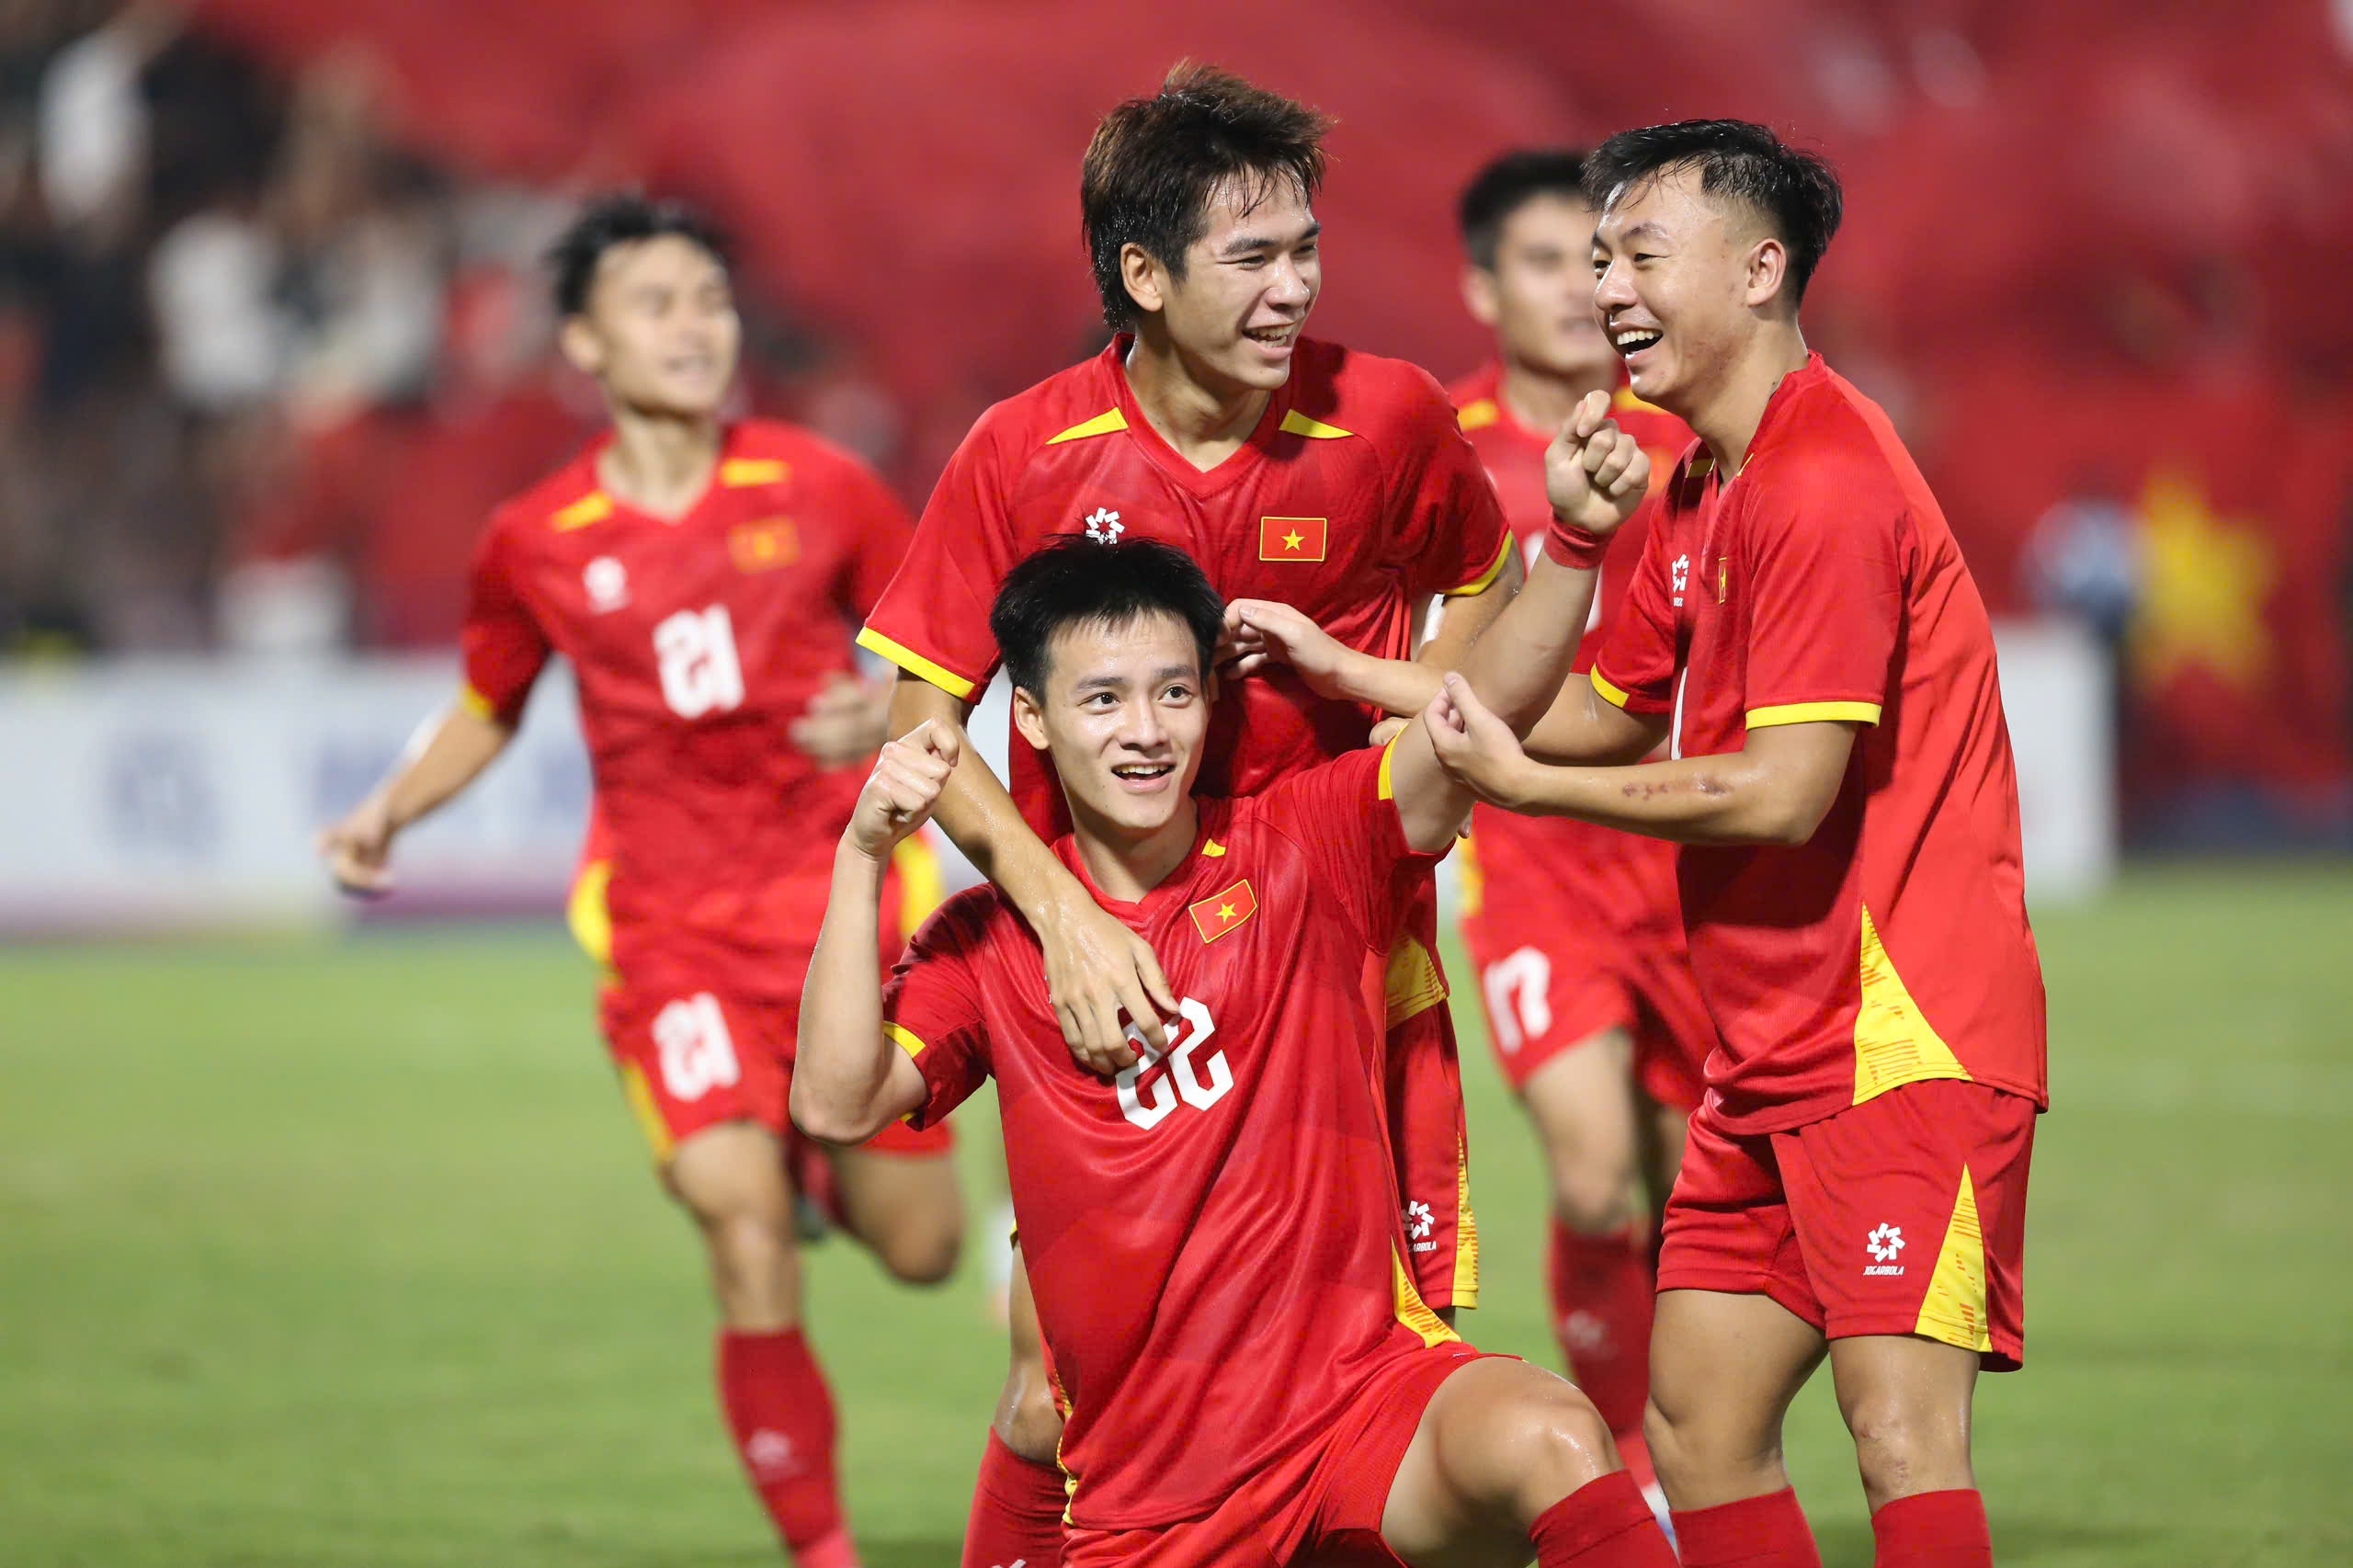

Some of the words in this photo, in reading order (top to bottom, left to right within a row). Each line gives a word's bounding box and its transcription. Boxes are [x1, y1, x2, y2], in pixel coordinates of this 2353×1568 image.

[652, 602, 745, 719] 21
[651, 992, 742, 1102] 21
[1483, 946, 1552, 1054] 17
[1115, 996, 1234, 1131] 22
